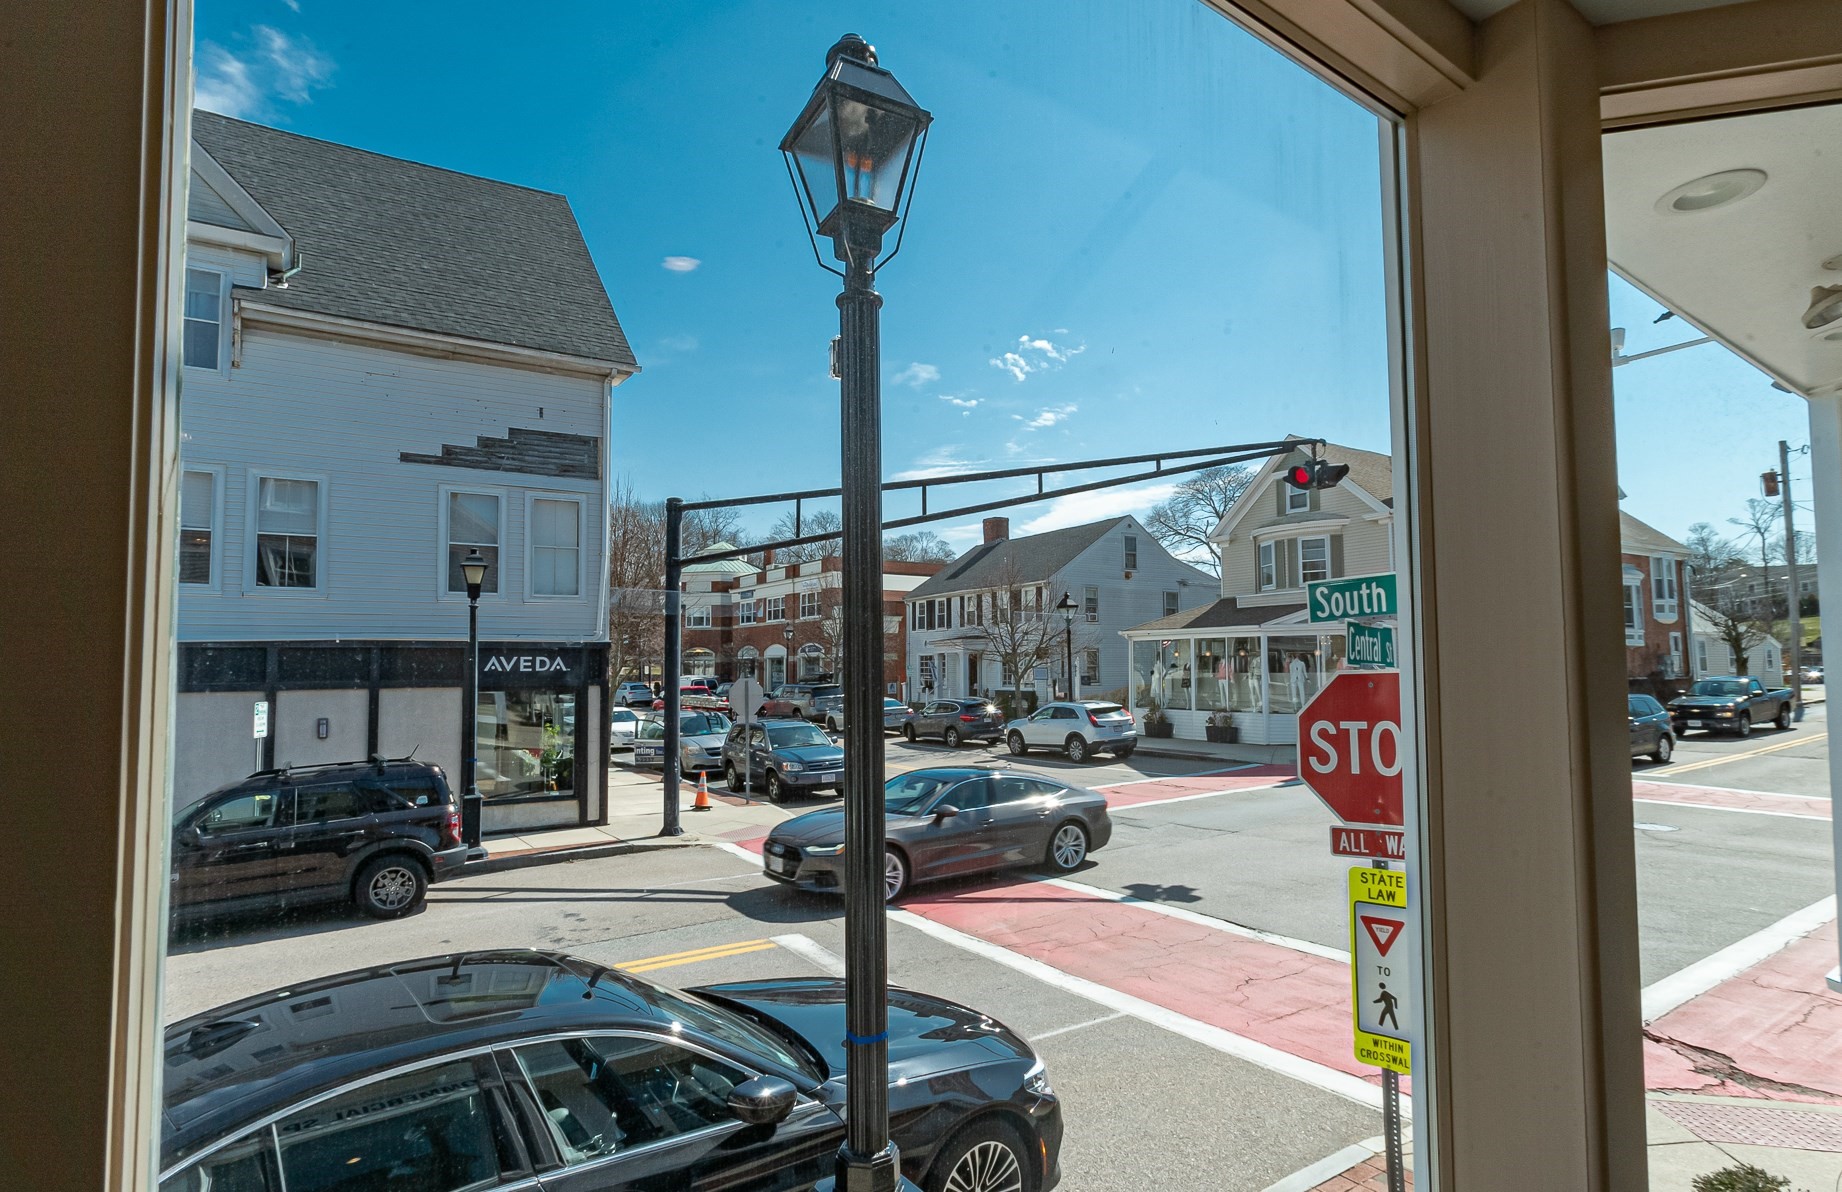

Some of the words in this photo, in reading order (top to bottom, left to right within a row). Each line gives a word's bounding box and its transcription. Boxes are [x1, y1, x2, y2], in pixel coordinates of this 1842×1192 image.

[1315, 581, 1387, 618] South
[1349, 626, 1382, 662] Central
[484, 656, 567, 671] AVEDA
[636, 747, 655, 756] nting
[1308, 720, 1402, 777] STO
[1339, 831, 1369, 853] ALL
[1385, 834, 1406, 856] WA
[1360, 872, 1404, 888] STATE
[1368, 887, 1396, 902] LAW
[1375, 926, 1390, 934] YIELD
[1376, 965, 1391, 977] TO
[1372, 1038, 1404, 1053] WITHIN
[1360, 1048, 1409, 1069] CROSSWAL
